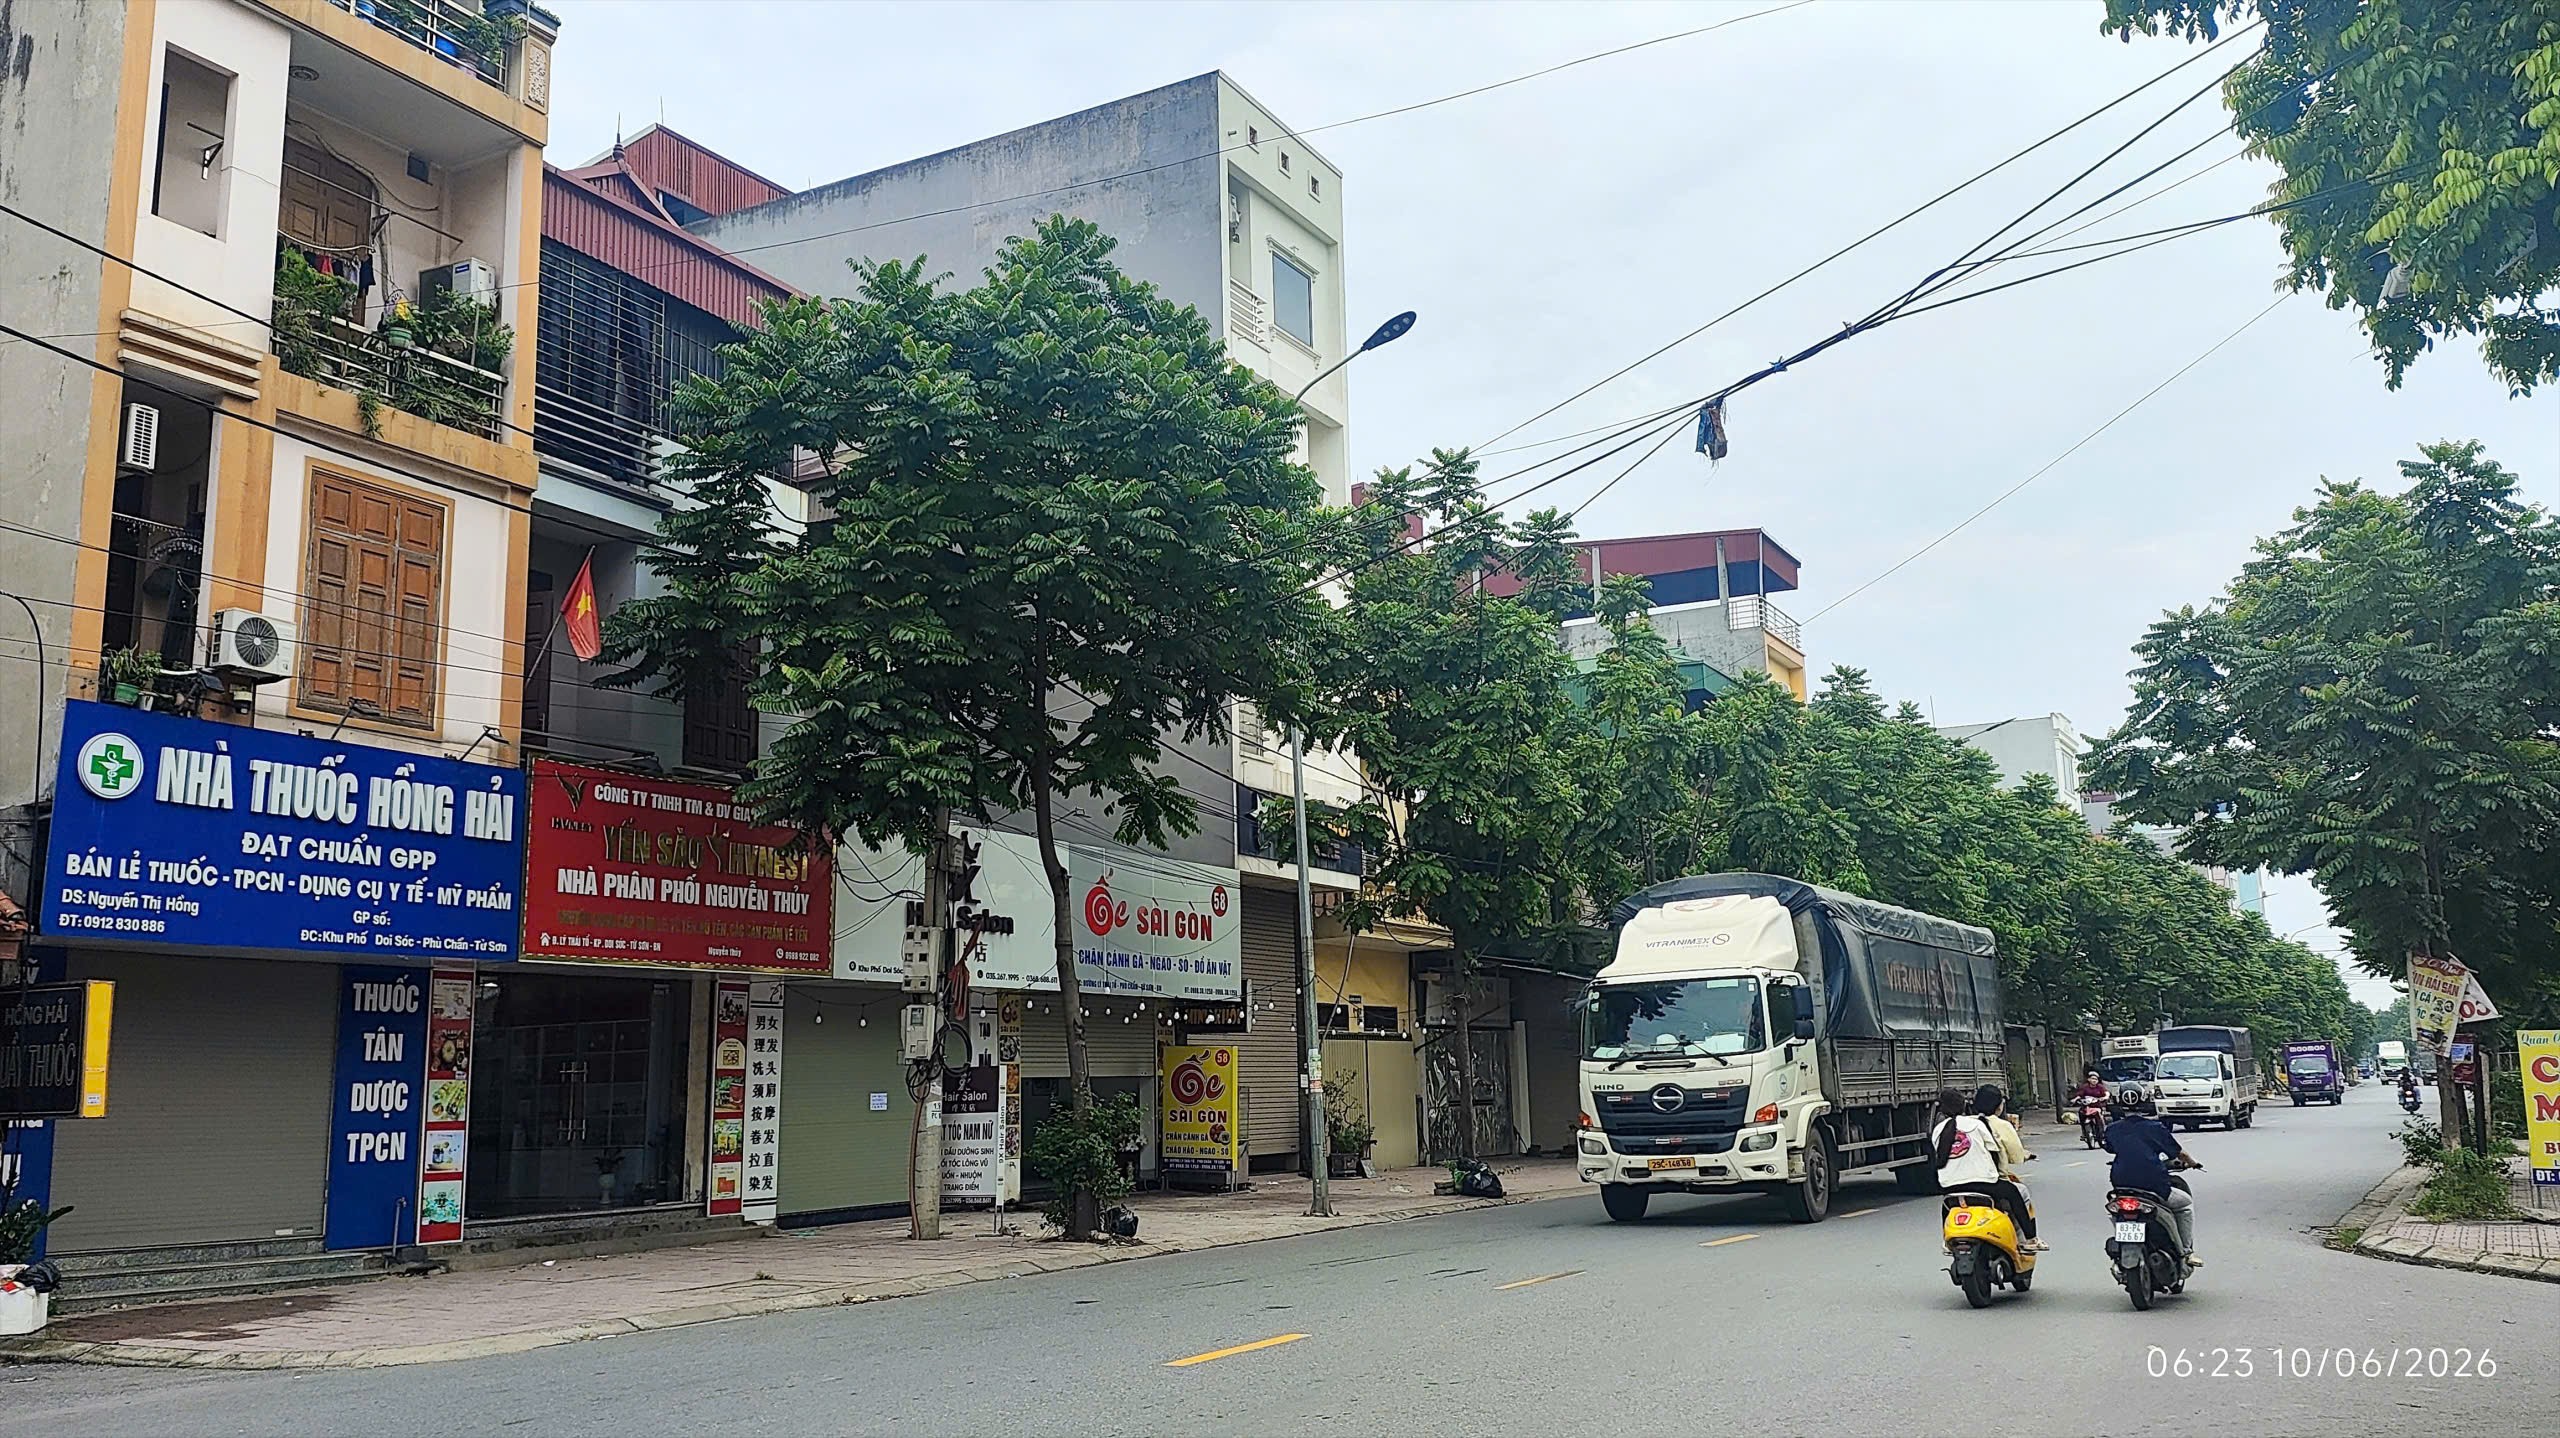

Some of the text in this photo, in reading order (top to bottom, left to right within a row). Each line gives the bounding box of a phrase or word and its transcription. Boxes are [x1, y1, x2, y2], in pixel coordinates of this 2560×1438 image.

[156, 741, 514, 841] NHÀ THUỐC HỒNG HẢI
[594, 783, 628, 804] CÔNG
[632, 791, 647, 806] TY
[651, 793, 682, 813] TNHH
[685, 798, 702, 811] TM
[705, 804, 713, 816] &
[716, 804, 731, 817] DV
[733, 806, 750, 821] GIA
[242, 832, 436, 870] ĐẠT CHUẨN GPP
[603, 817, 650, 865] YẾN
[66, 847, 112, 877] BÁN
[119, 851, 140, 880] LẺ
[149, 856, 218, 886] THUỐC
[234, 869, 284, 892] TPCN
[299, 875, 351, 901] DỤNG
[357, 880, 382, 905] CỤ
[389, 883, 401, 901] Y
[407, 877, 428, 903] TẾ
[466, 883, 512, 910] PHẨM
[558, 866, 810, 915] NHÀ PHÂN PHỐI NGUYỄN THỦY
[62, 889, 87, 904] DS:
[142, 895, 161, 914] Thị
[166, 895, 199, 916] Hồng
[59, 914, 165, 932] ĐT: 0912 830 886
[353, 911, 391, 925] GP số:
[956, 906, 1014, 935] Salon
[1136, 897, 1168, 936] SÀI
[1175, 901, 1212, 941] GÒN
[1214, 892, 1226, 911] 58
[346, 930, 367, 944] Phố
[375, 933, 393, 945] Doi
[394, 935, 414, 947] Sóc
[423, 936, 441, 949] Phù
[488, 941, 507, 953] Sơn
[1646, 937, 1710, 948] VITRANIMEX
[858, 965, 869, 973] Khu
[1079, 948, 1104, 965] CHÂN
[1106, 950, 1129, 968] CÁNH
[1132, 952, 1144, 969] GÀ
[1150, 957, 1172, 971] NGAO
[353, 974, 420, 1014] THUỐC
[5, 997, 68, 1025] HỒNG HẢI
[755, 1015, 779, 1031] 男女
[363, 1027, 403, 1062] TÂN
[754, 1038, 778, 1053] 理发
[29, 1029, 76, 1088] THUỐC
[753, 1061, 777, 1076] 洗头
[1217, 1052, 1229, 1064] 58
[350, 1081, 408, 1118] DƯỢC
[962, 1090, 987, 1101] Salon
[751, 1106, 775, 1123] 按摩
[1170, 1104, 1227, 1124] SÀI GÒN
[948, 1119, 994, 1140] TÓC NAM NỮ
[347, 1131, 406, 1163] TPCN
[981, 1147, 994, 1155] SINH
[944, 1183, 964, 1191] TRANG
